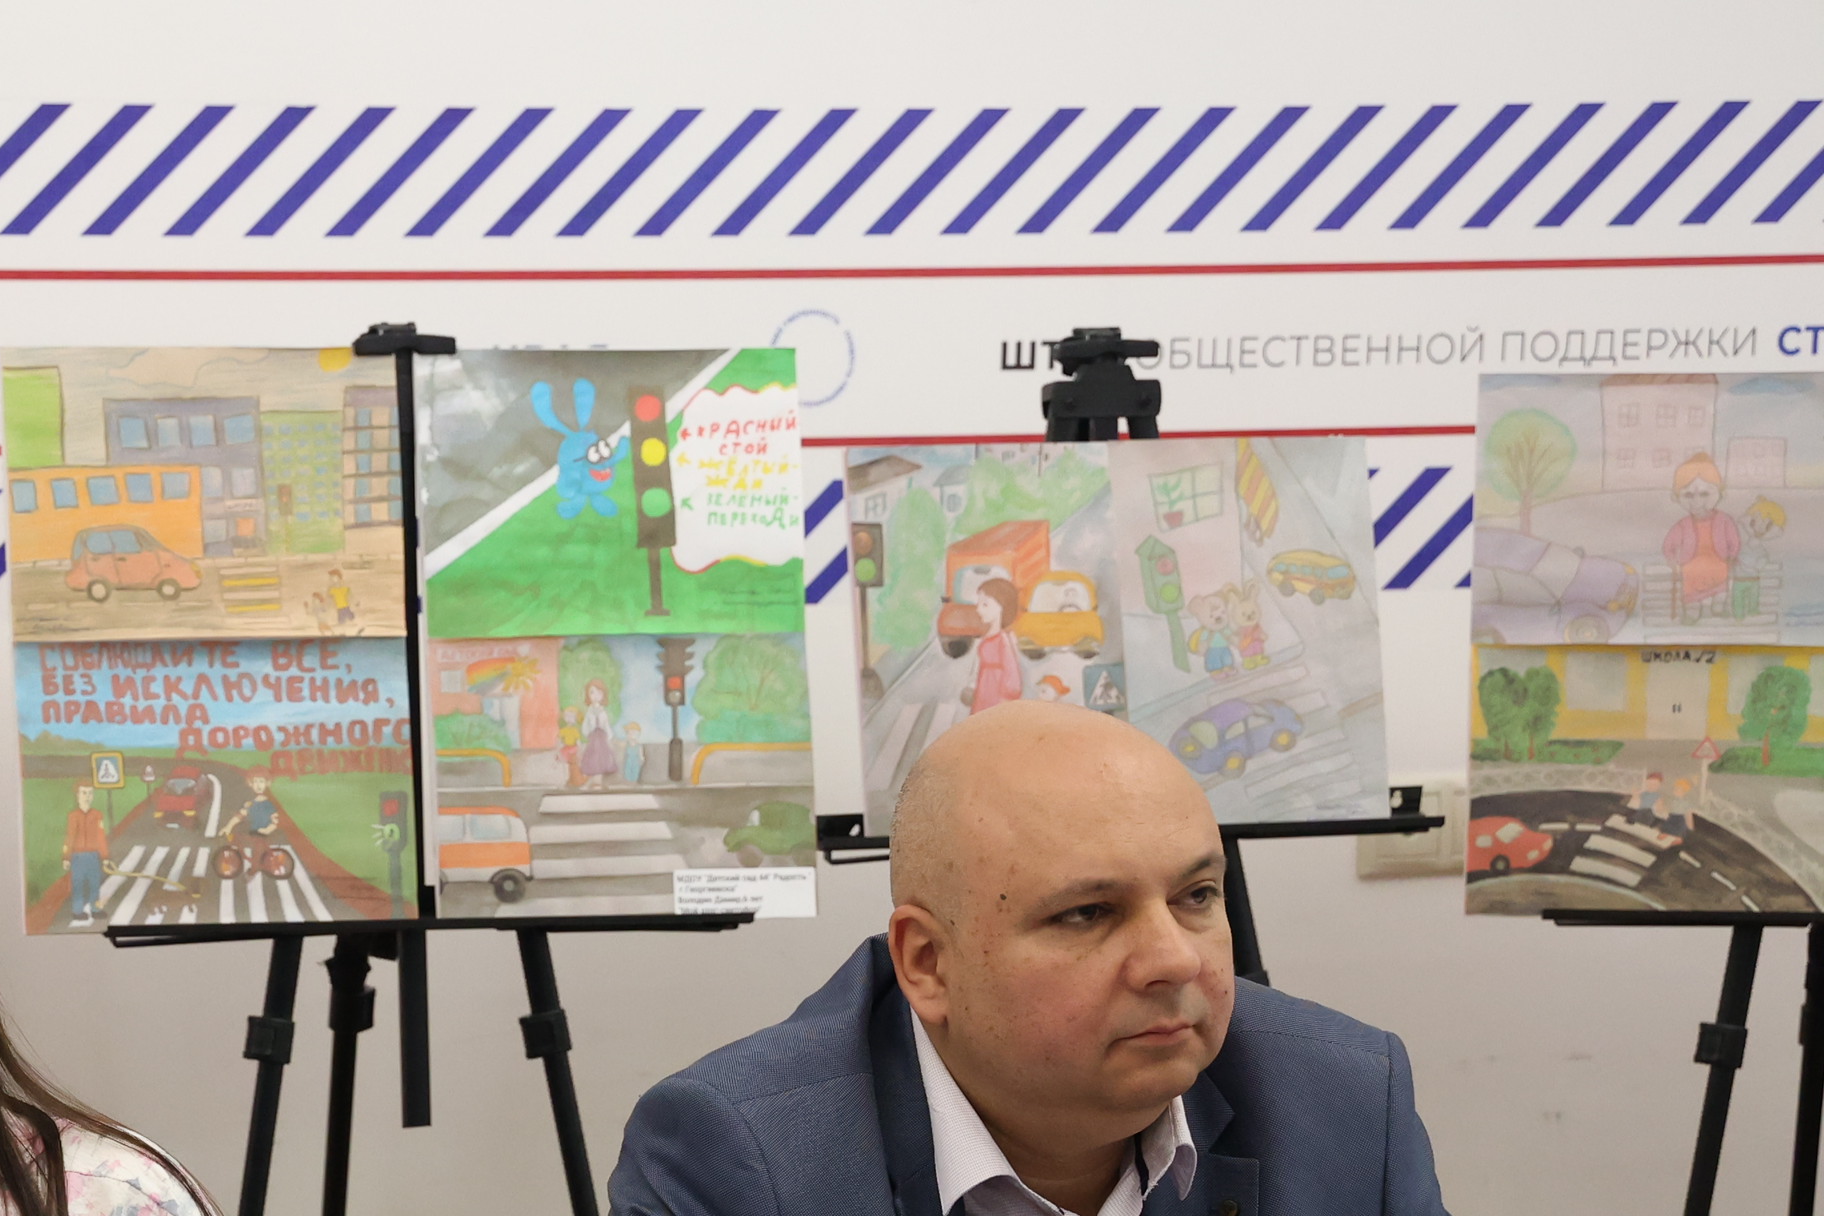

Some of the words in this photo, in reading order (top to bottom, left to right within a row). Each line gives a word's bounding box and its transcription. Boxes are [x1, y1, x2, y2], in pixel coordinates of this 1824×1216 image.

[1501, 326, 1757, 367] ПОДДЕРЖКИ
[697, 409, 796, 438] КРАСНЫЙ
[719, 437, 768, 456] СТОЙ
[705, 475, 764, 491] ЖДИ
[707, 507, 799, 530] ПЕРЕХОДИ
[271, 639, 353, 674] ВСЕ,
[42, 672, 97, 696] БЕЗ
[111, 671, 395, 708] ИСКЛЮЧЕНИЯ,
[42, 699, 210, 726] ПРАВИЛА
